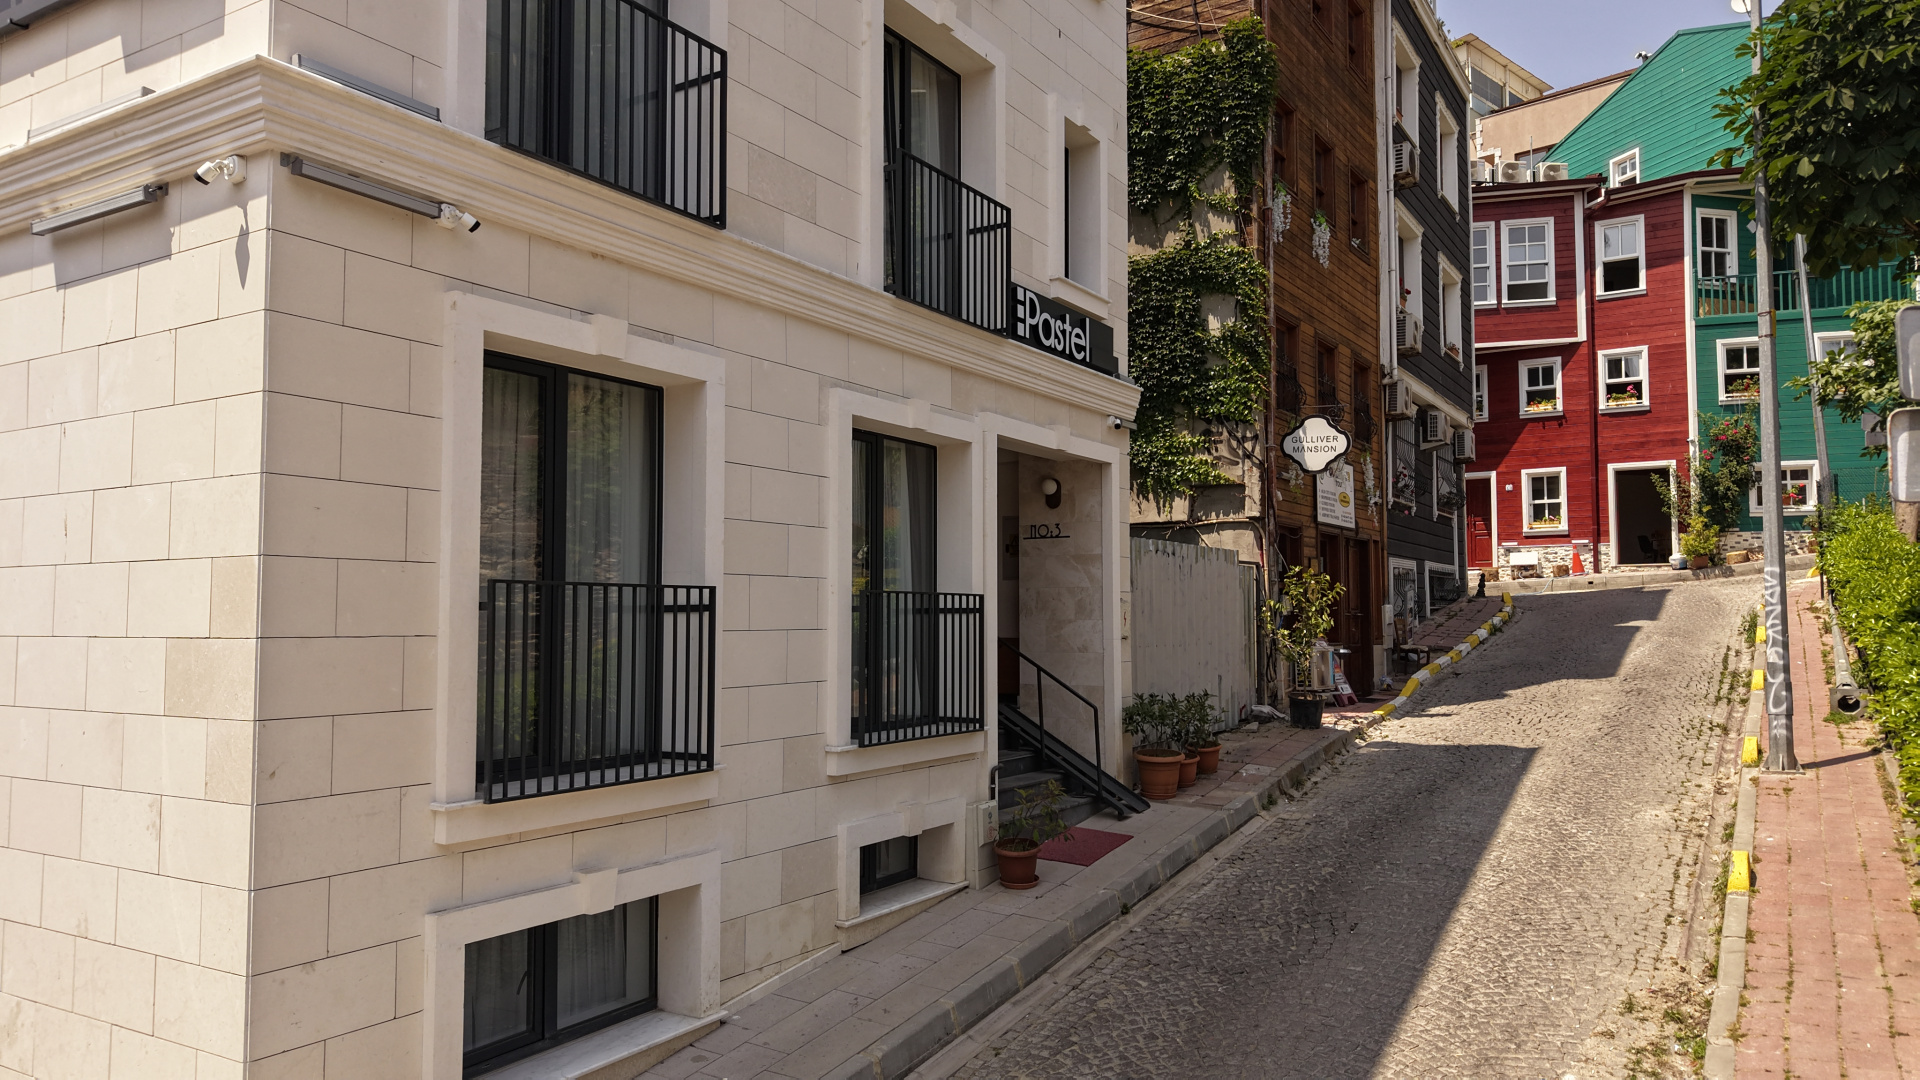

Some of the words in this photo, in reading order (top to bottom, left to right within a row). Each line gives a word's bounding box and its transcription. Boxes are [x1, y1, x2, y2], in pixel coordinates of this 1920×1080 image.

[1025, 289, 1090, 363] Pastel
[1291, 435, 1339, 444] GULLIVER
[1292, 445, 1337, 454] MANSION
